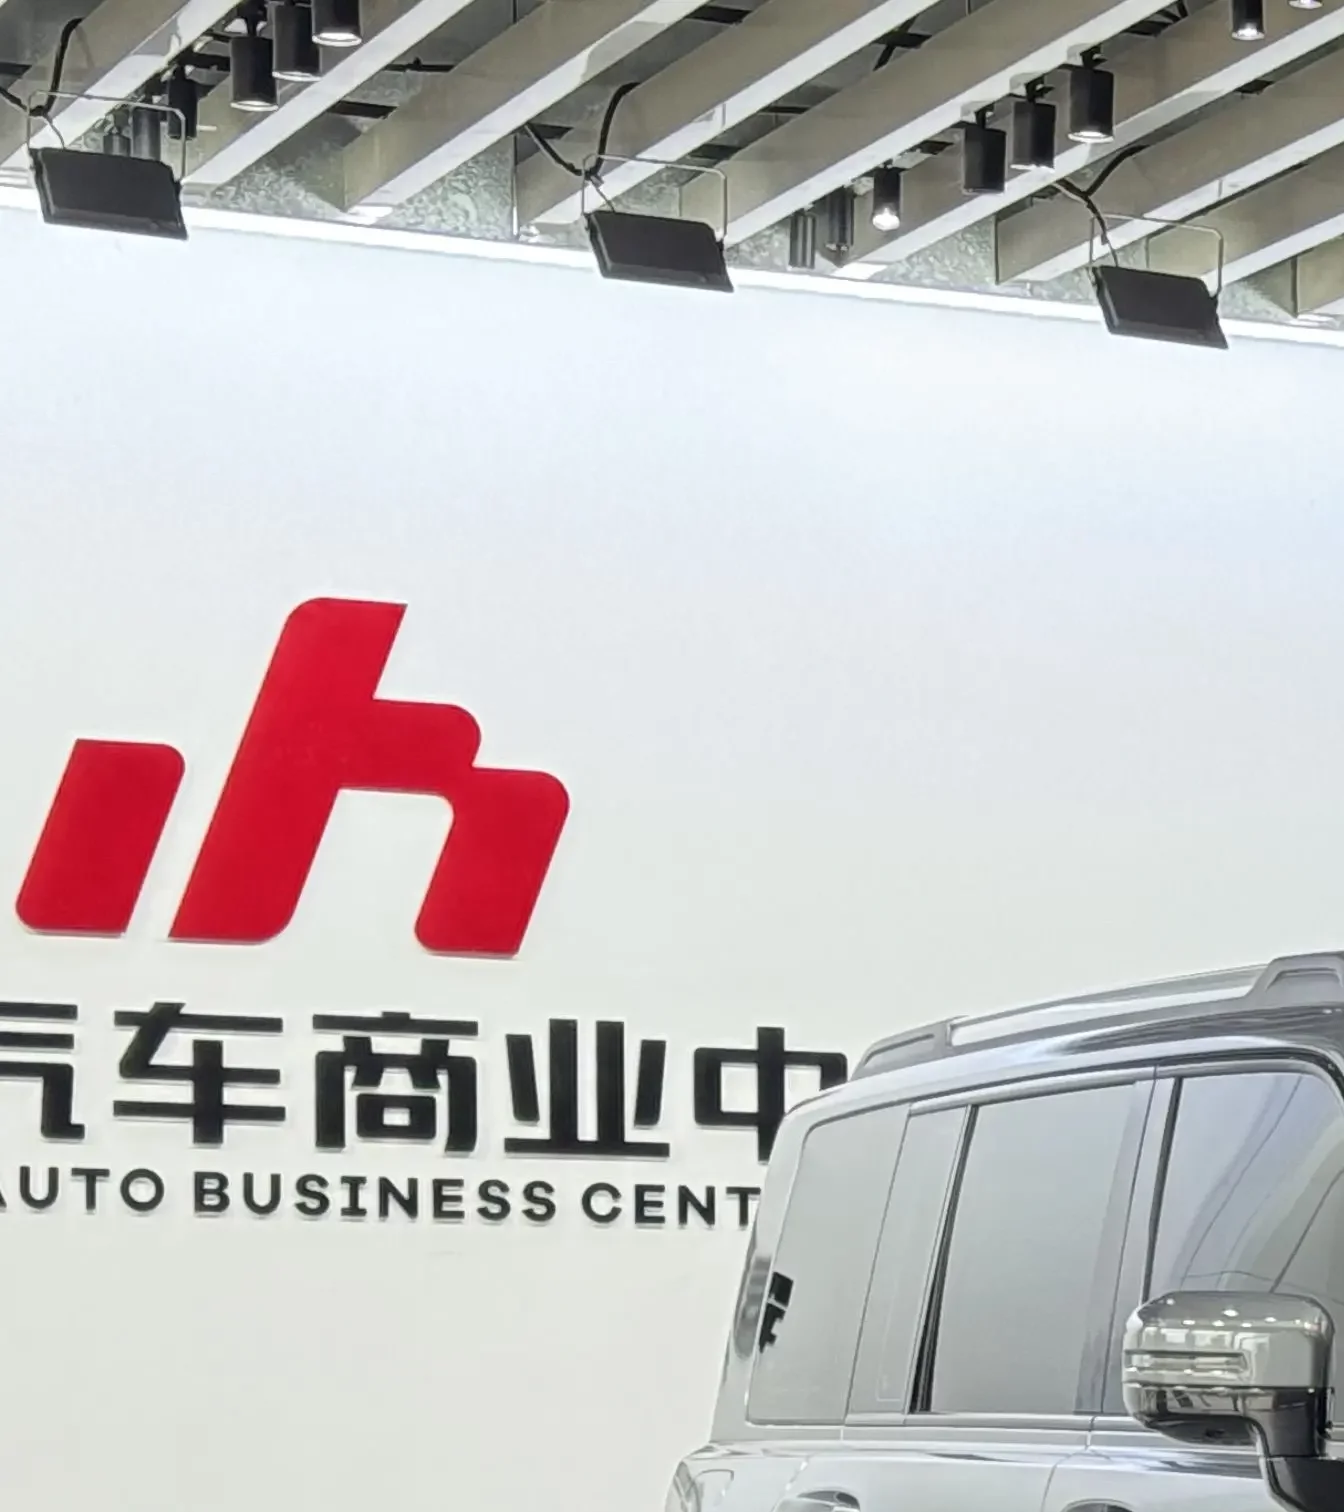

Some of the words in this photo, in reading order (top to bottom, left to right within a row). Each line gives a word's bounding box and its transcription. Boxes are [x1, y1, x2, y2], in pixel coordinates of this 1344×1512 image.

[0, 1166, 165, 1212] UTO
[193, 1170, 558, 1222] BUSINESS
[580, 1182, 762, 1228] CENT
